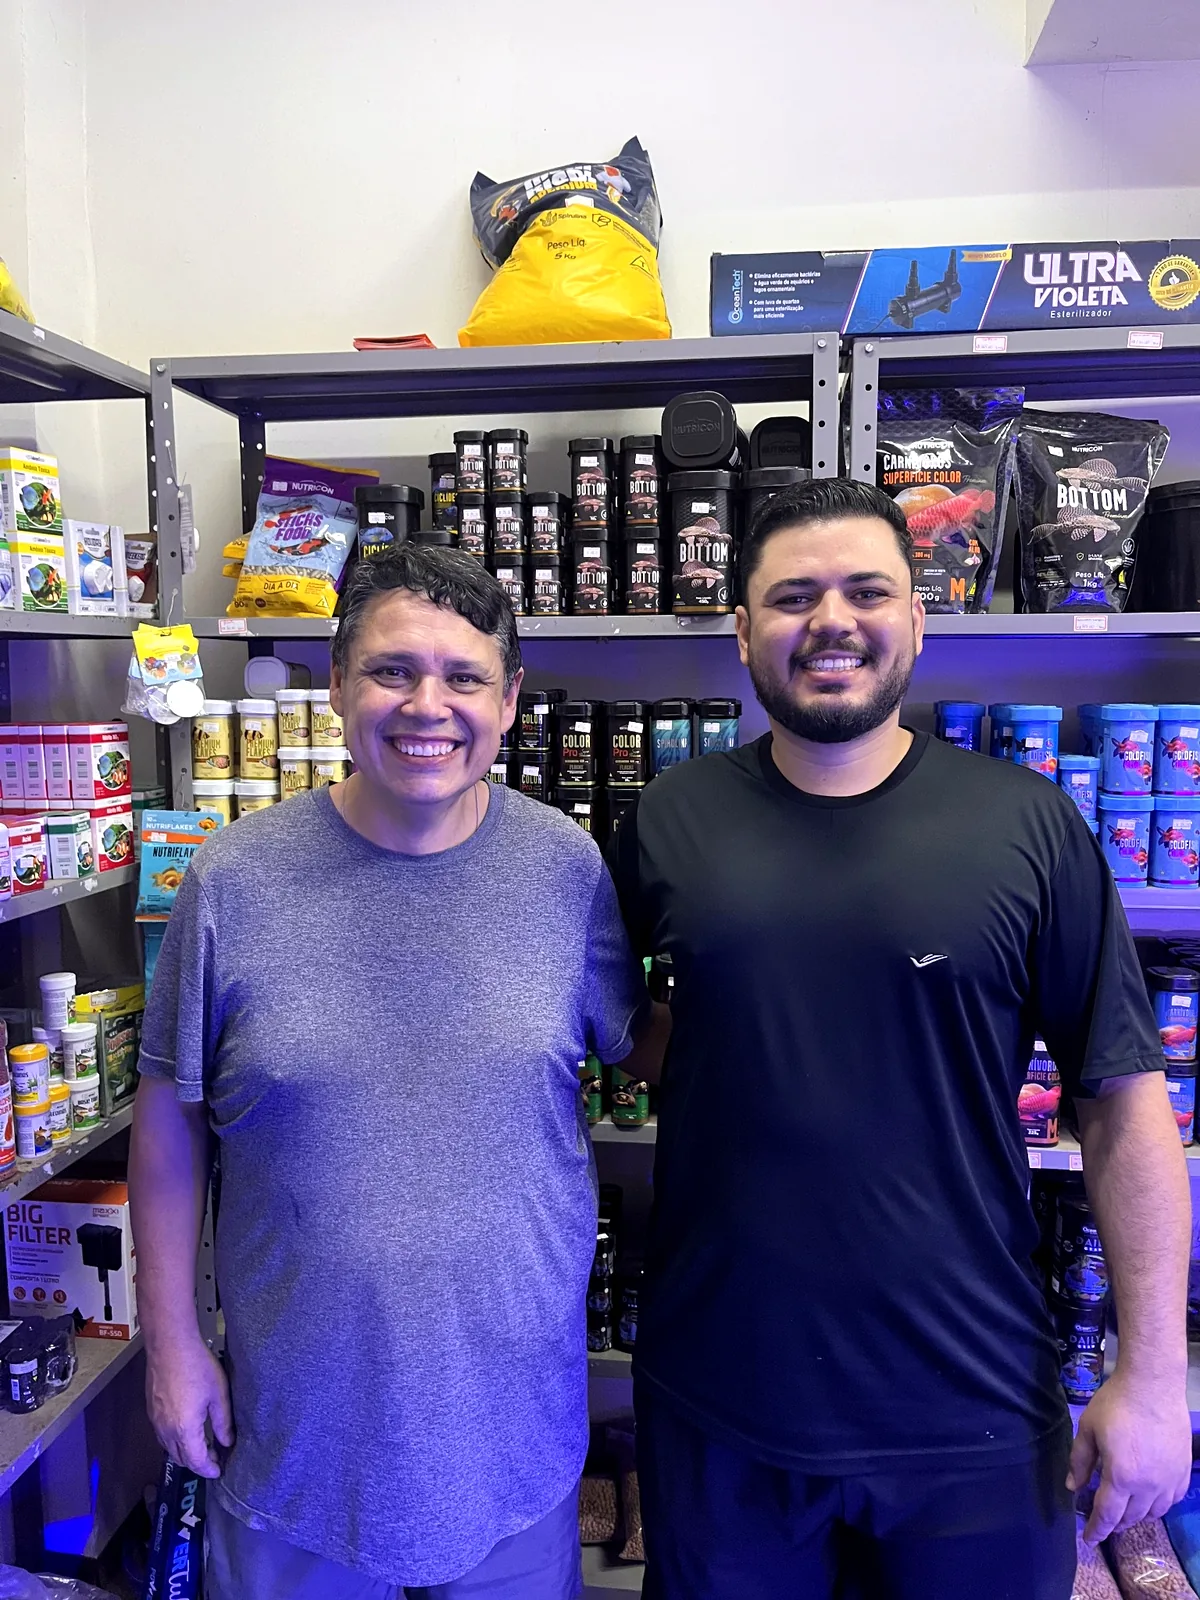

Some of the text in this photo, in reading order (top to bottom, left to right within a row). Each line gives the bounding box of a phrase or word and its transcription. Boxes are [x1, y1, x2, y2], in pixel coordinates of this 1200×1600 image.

[547, 241, 569, 250] Peso
[555, 252, 562, 260] 5
[1024, 251, 1143, 284] ULTRA
[1034, 285, 1129, 308] VIOLETA
[1050, 309, 1113, 319] Esterilizador
[674, 421, 720, 435] NUTRICON
[1071, 445, 1103, 453] NUTRICON
[460, 461, 484, 471] BOTTOM
[495, 459, 519, 469] BOTTOM
[883, 471, 931, 485] SUPERFICIE
[933, 471, 961, 483] COLOR
[292, 482, 335, 495] NUTRICON
[576, 482, 607, 496] BOTTOM
[1056, 484, 1128, 511] BOTTOM
[276, 513, 323, 528] STICKS
[461, 524, 485, 534] BOTTOM
[496, 522, 520, 532] BOTTOM
[534, 522, 557, 532] BOTTOM
[275, 526, 312, 541] FOOD
[679, 543, 728, 563] BOTTOM
[576, 571, 607, 584] BOTTOM
[264, 582, 276, 590] DIA
[285, 581, 299, 590] DIA
[505, 584, 521, 594] TTOM
[534, 584, 558, 594] BOTTOM
[950, 577, 965, 601] M
[919, 592, 940, 602] 00g
[522, 714, 543, 724] COLOR
[562, 734, 591, 748] COLOR
[612, 734, 641, 748] COLOR
[562, 748, 578, 757] Pro
[613, 748, 629, 757] Pro
[521, 774, 542, 784] COLOR
[152, 846, 197, 858] NUTRIFLAK
[7, 1204, 43, 1224] BIG
[8, 1224, 72, 1246] FILTER
